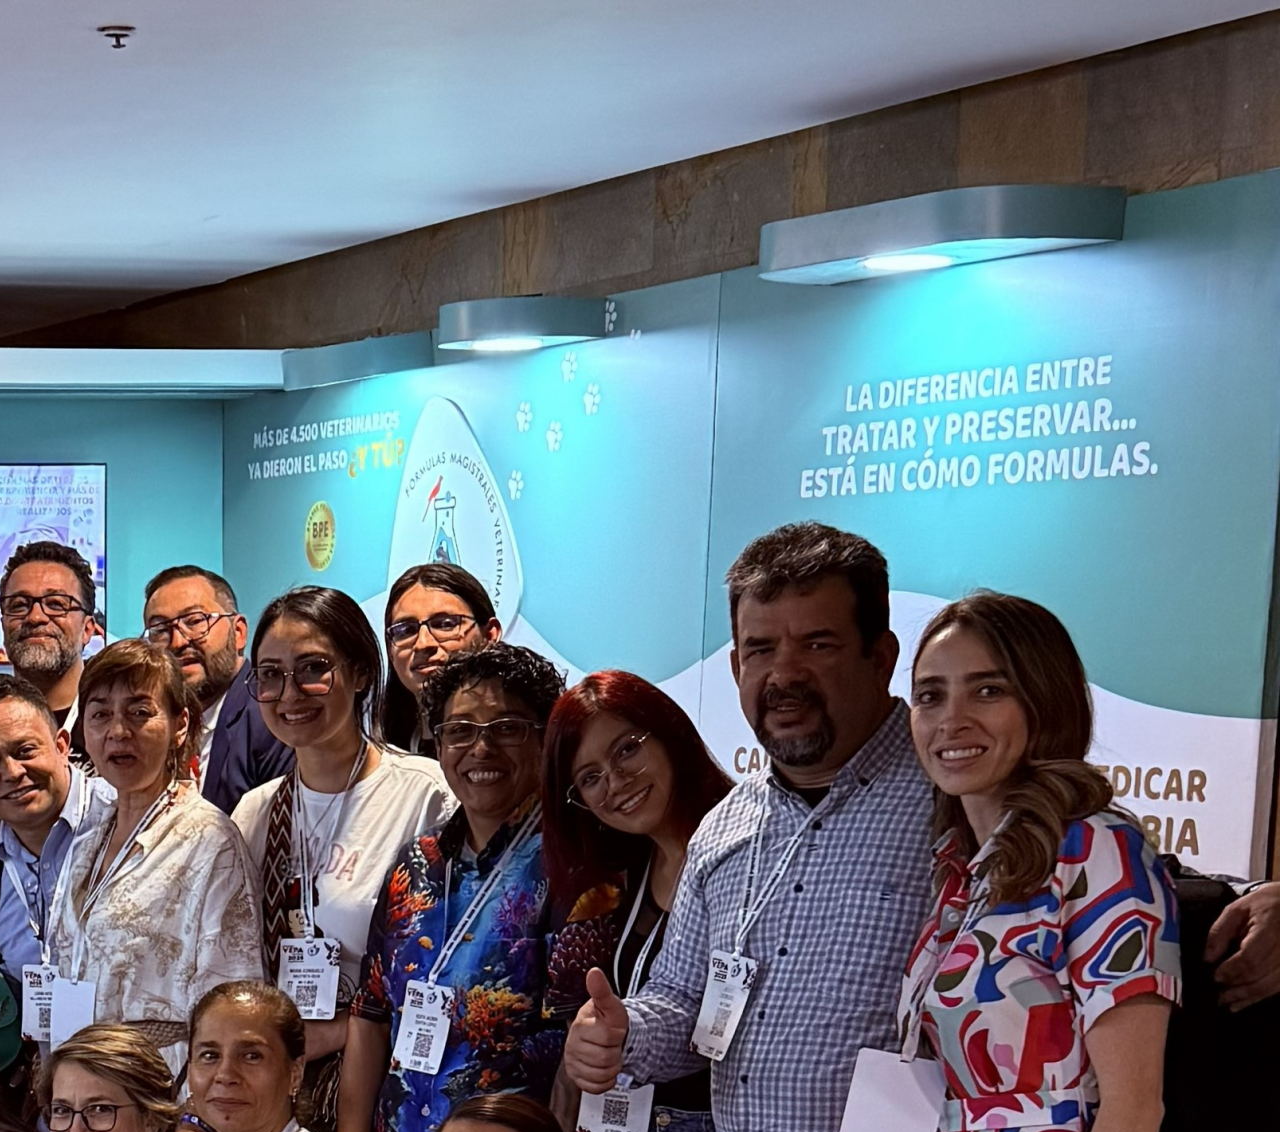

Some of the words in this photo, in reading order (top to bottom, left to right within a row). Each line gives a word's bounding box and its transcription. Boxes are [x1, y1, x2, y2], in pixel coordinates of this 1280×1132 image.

[846, 382, 874, 413] LA
[879, 365, 1019, 410] DIFERENCIA
[1025, 355, 1113, 392] ENTRE
[253, 425, 274, 449] MÁS
[276, 428, 289, 447] DE
[290, 423, 318, 444] 4.500
[320, 410, 400, 439] VETERINARIOS
[822, 418, 916, 456] TRATAR
[922, 415, 940, 445] Y
[945, 398, 1137, 443] PRESERVAR...
[248, 462, 261, 480] YA
[262, 456, 302, 478] DIERON
[304, 454, 316, 473] EL
[319, 449, 347, 471] PASO
[450, 453, 497, 513] MAGISTRALES
[800, 455, 857, 499] ESTÁ
[863, 464, 895, 494] EN
[901, 448, 980, 491] CÓMO
[987, 442, 1159, 485] FORMULAS.
[312, 521, 329, 539] BPE
[734, 746, 768, 774] CA
[1096, 765, 1207, 803] DICAR
